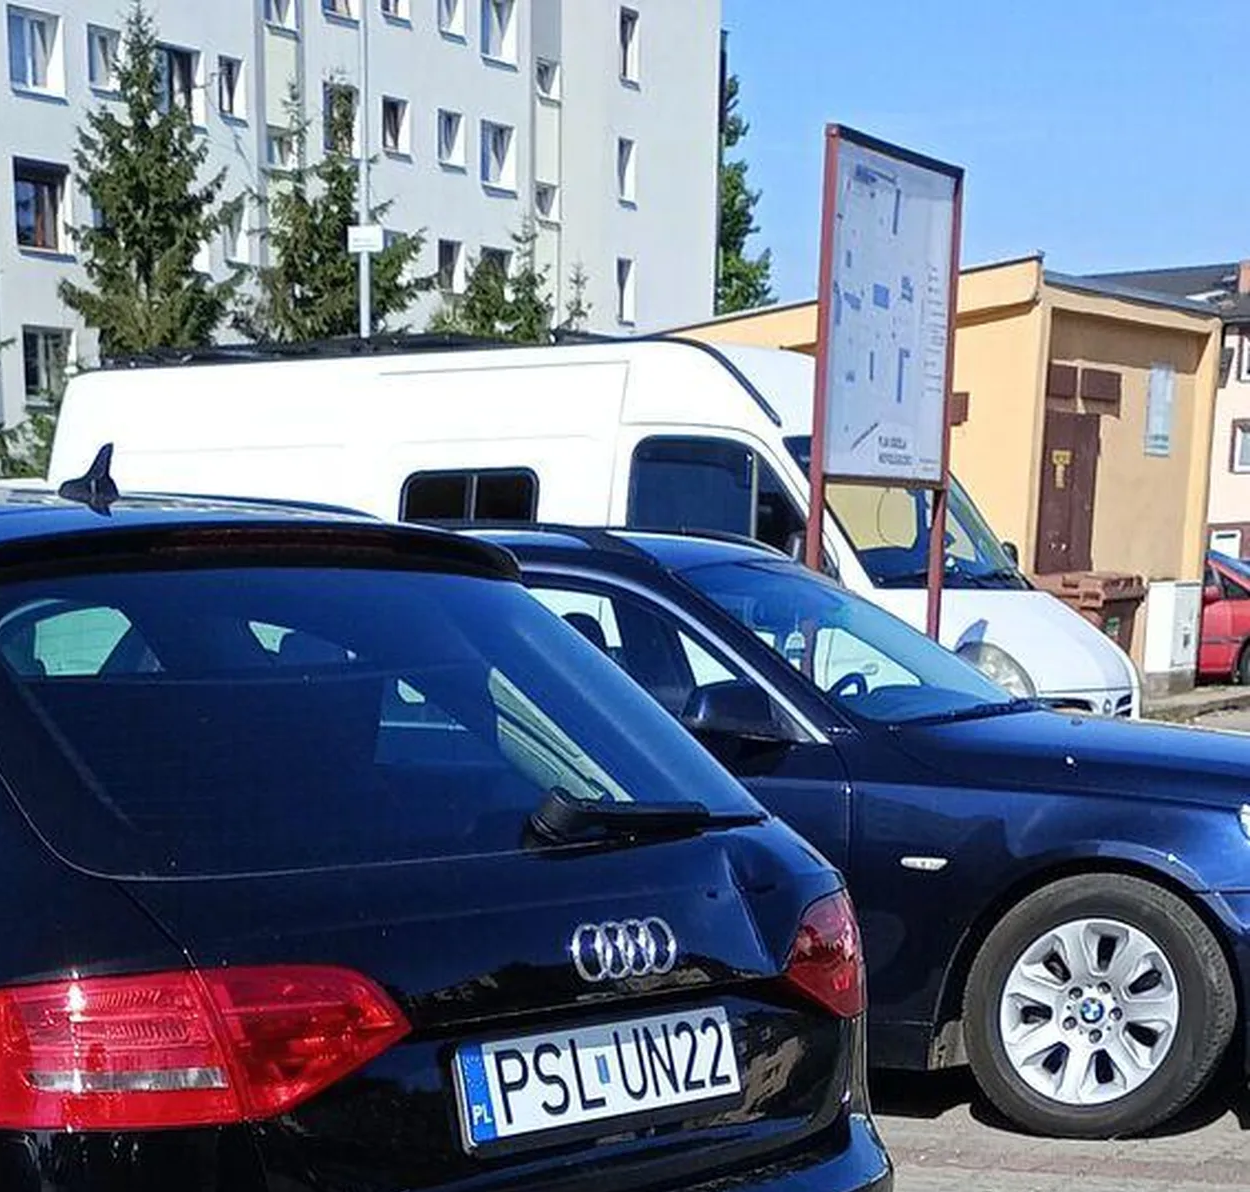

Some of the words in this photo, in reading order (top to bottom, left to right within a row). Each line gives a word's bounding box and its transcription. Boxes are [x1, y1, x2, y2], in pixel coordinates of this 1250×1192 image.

[494, 1038, 606, 1125] PSL
[613, 1017, 732, 1101] UN22
[472, 1105, 493, 1124] PL
